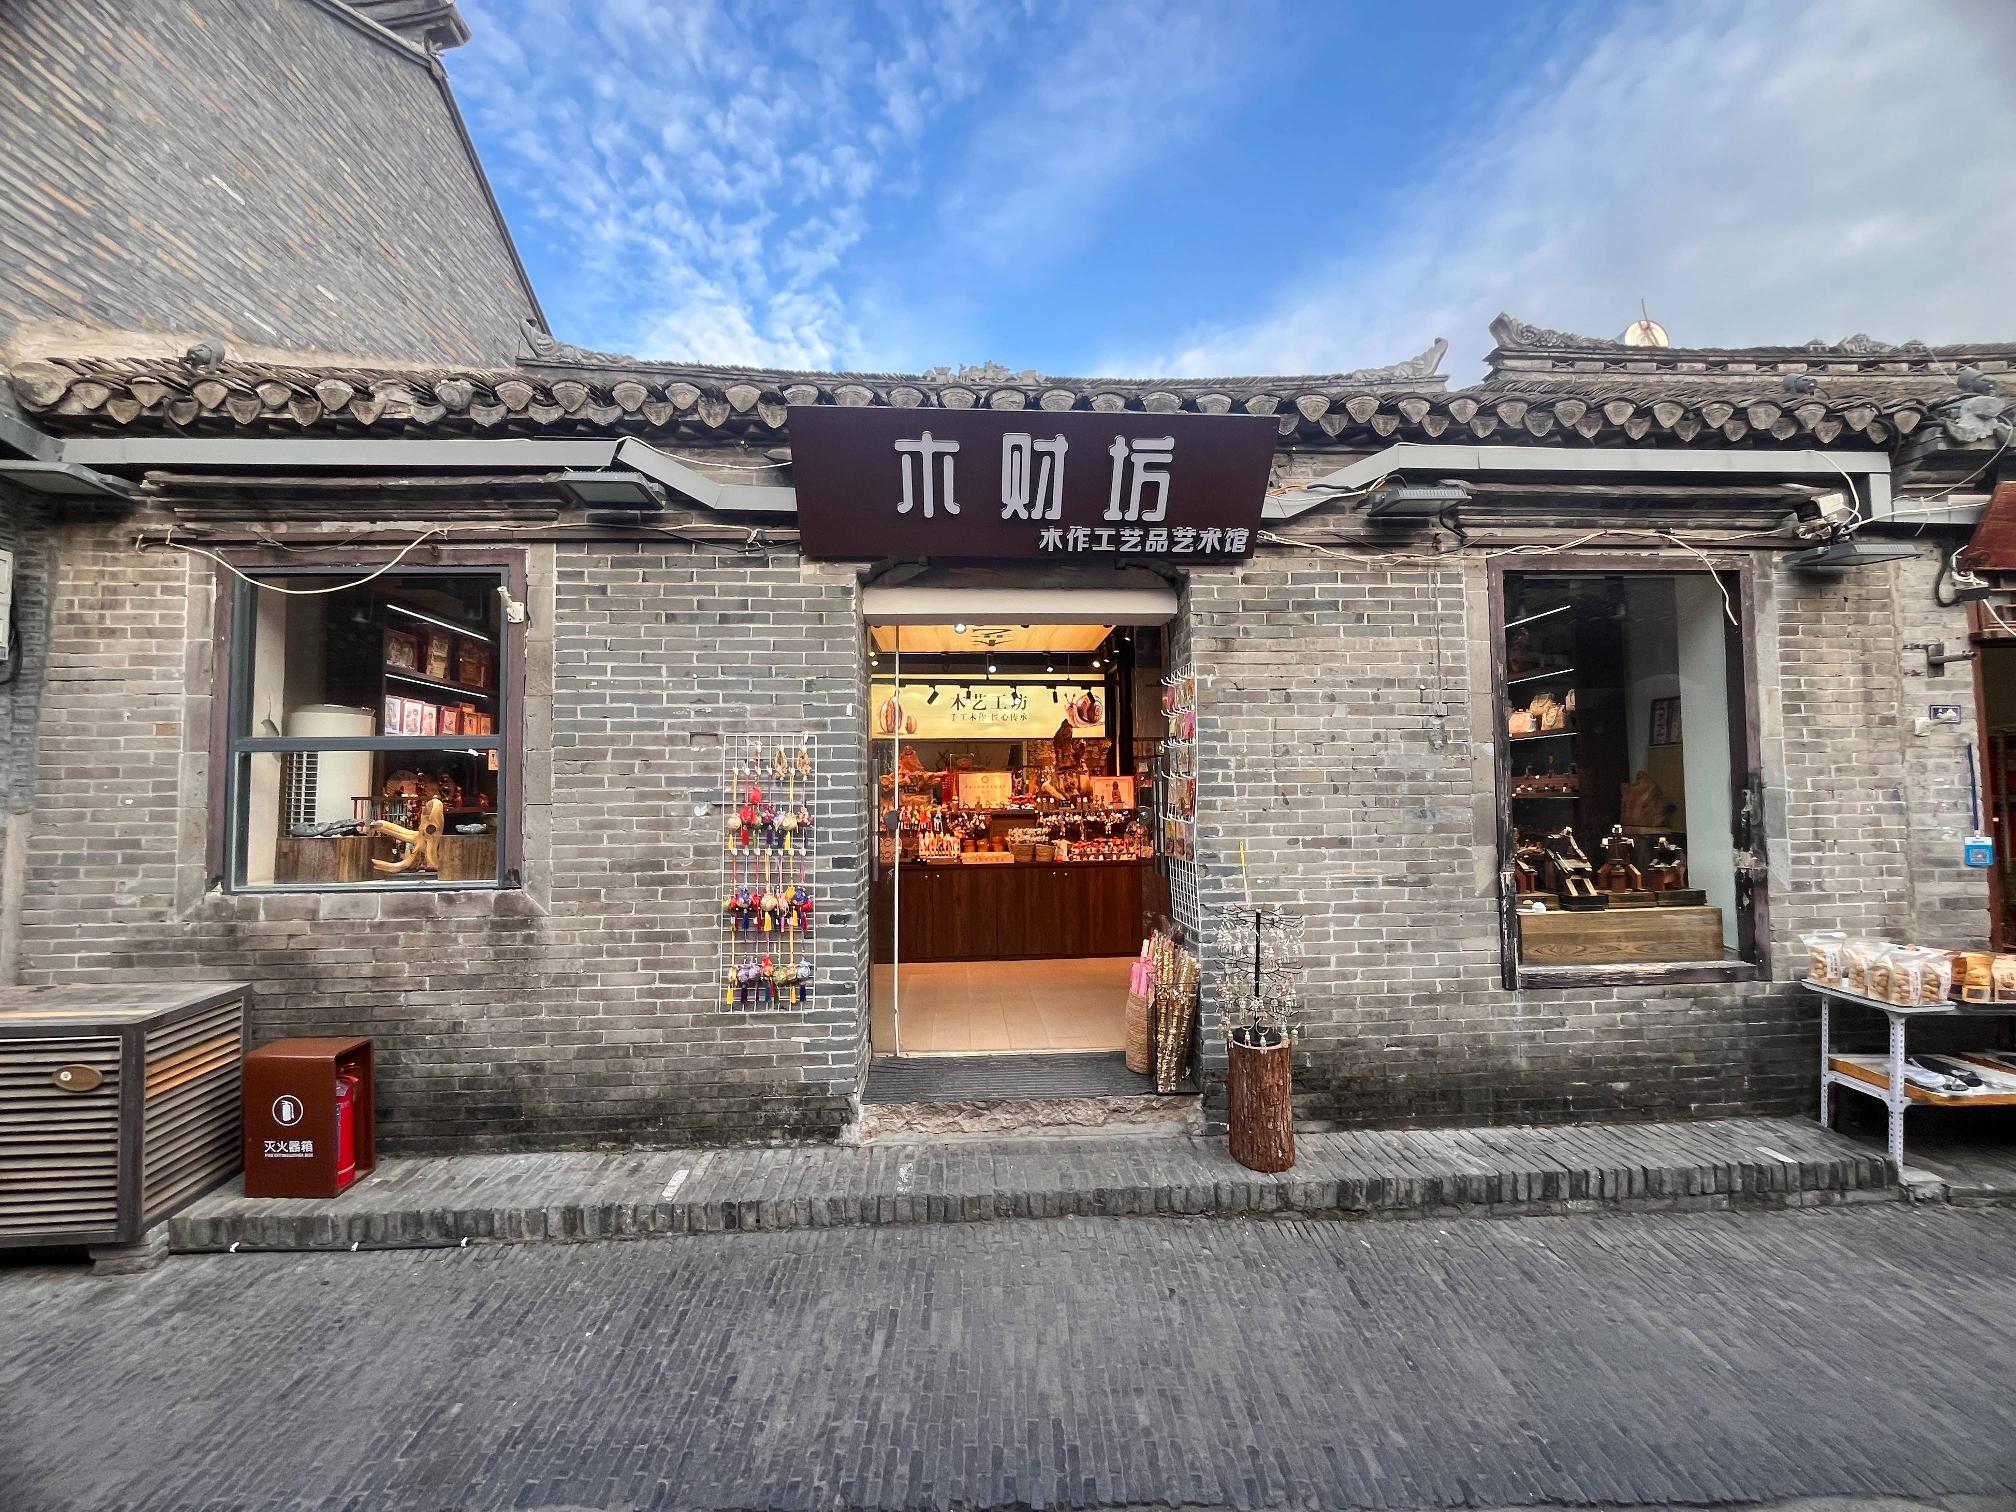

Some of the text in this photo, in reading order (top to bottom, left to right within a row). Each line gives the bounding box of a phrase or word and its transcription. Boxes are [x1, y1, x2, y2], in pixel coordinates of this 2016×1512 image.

[893, 430, 1176, 522] 木财坊
[1038, 526, 1250, 553] 木作工艺品艺术馆
[951, 693, 1028, 711] 木艺工坊
[264, 1140, 314, 1153] 灭火器箱
